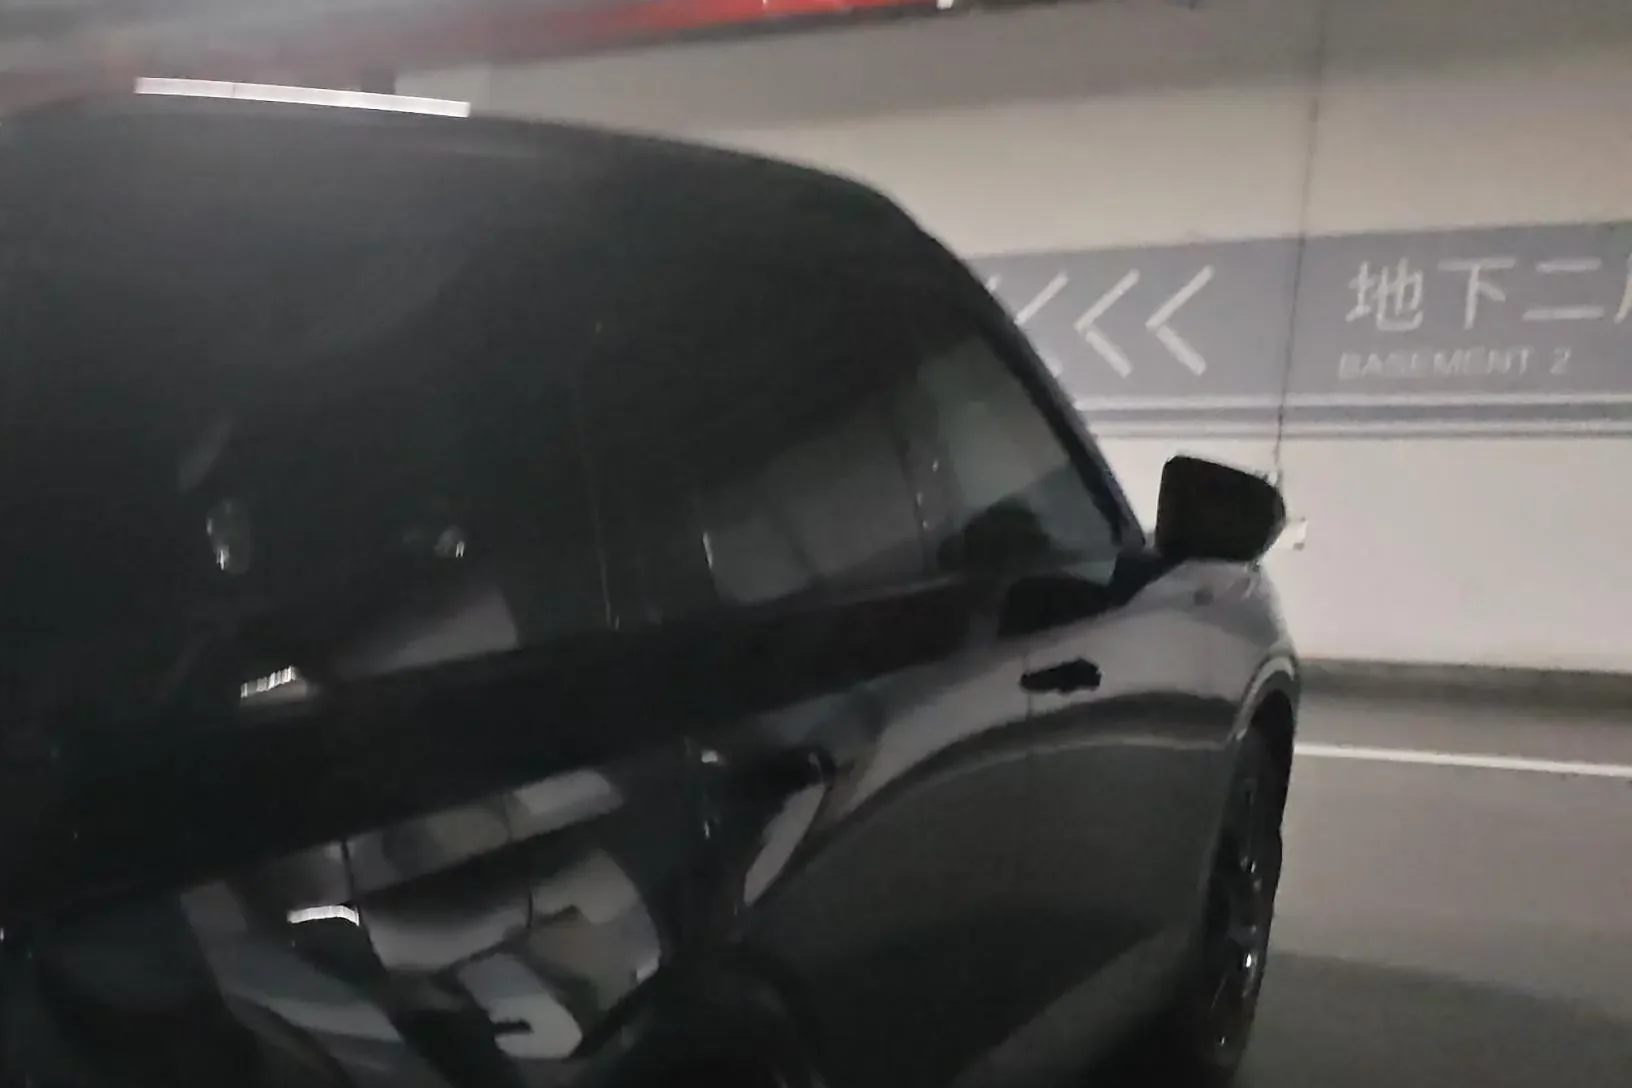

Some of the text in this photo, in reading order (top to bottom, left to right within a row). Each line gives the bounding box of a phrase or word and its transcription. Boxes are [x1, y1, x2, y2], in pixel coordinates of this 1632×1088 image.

[1345, 255, 1632, 332] 地下二
[1338, 346, 1572, 380] BASEMENT 2
